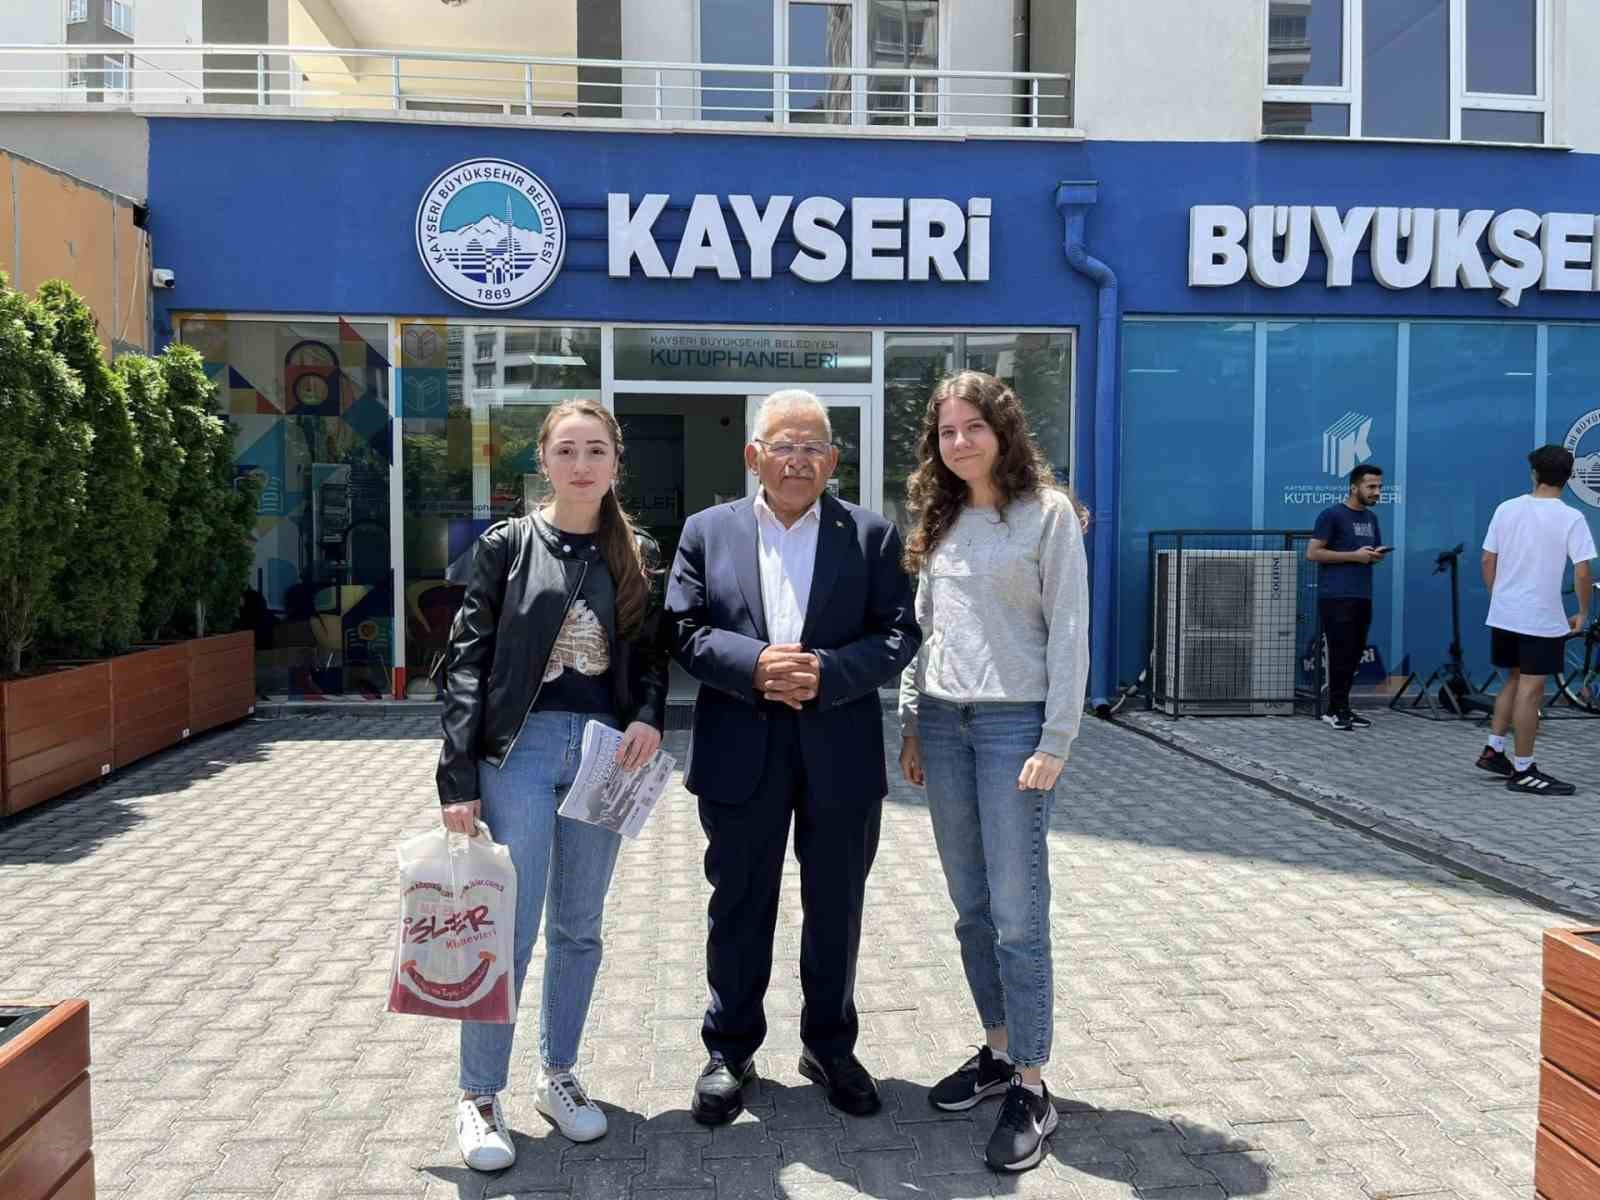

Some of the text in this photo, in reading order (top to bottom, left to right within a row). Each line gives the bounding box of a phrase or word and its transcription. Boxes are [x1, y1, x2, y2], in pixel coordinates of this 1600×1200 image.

[427, 167, 557, 264] KAYSERİ BÜYÜKŞEHİR BELEDİYESİ
[607, 193, 1600, 307] KAYSERİ BÜYÜKŞE
[477, 287, 511, 300] 1869
[650, 348, 839, 369] KÜTÜPHANELERİ
